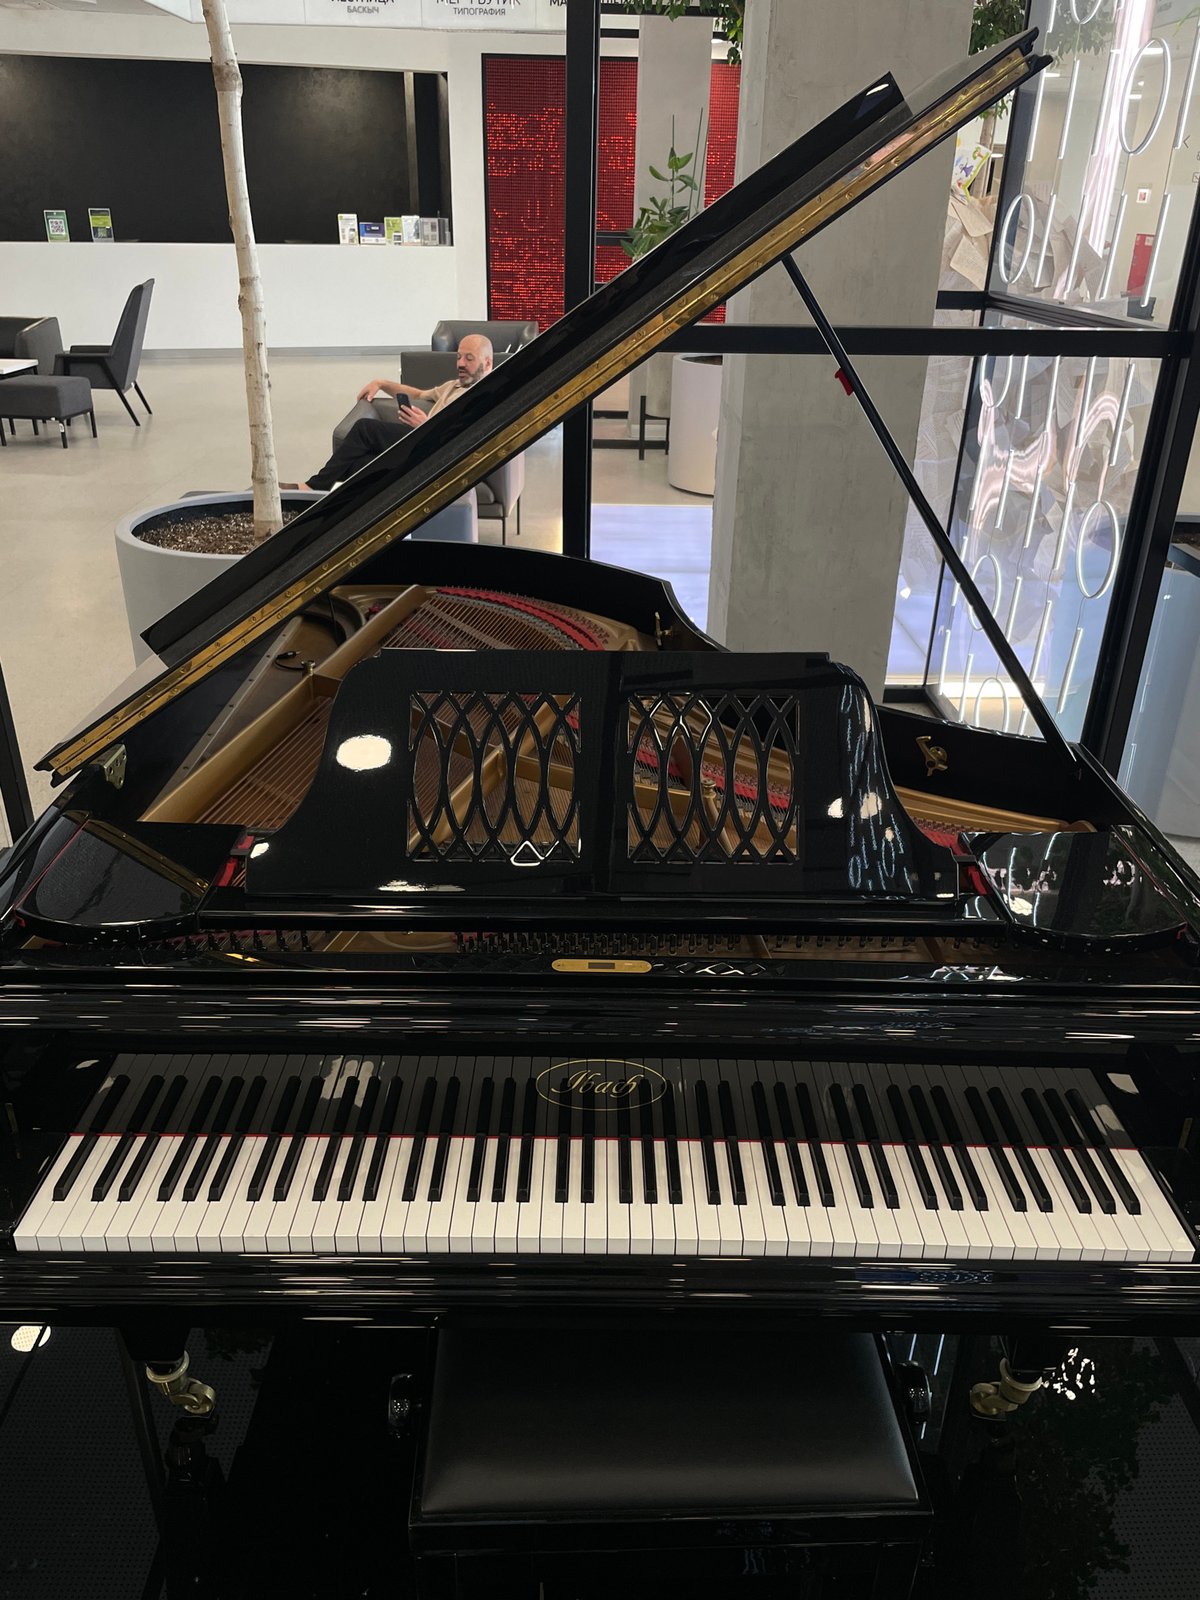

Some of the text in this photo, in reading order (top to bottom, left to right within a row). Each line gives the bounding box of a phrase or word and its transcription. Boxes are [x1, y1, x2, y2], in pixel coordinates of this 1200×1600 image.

[347, 5, 379, 13] БАСКЫЧ
[453, 7, 506, 16] ТИПОГРАФИЯ
[551, 1069, 645, 1099] Ibach
